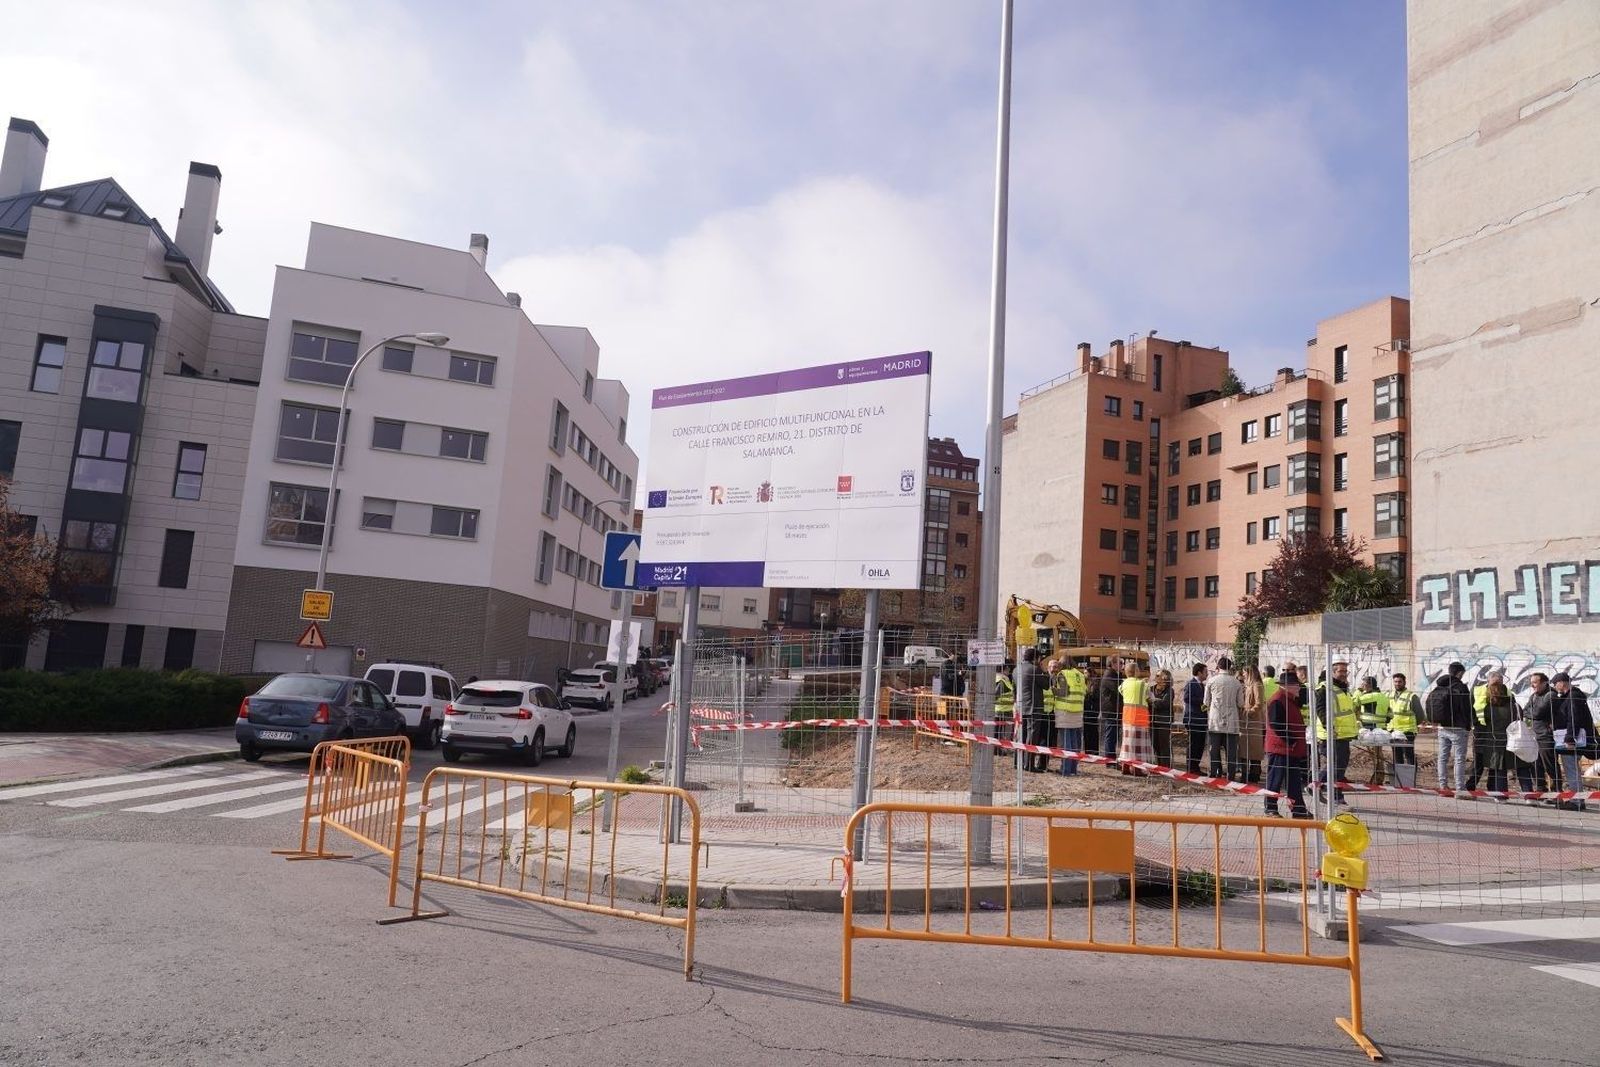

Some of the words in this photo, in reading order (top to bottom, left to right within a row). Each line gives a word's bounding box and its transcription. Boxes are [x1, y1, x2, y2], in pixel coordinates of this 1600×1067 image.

[883, 358, 921, 371] MADRID
[672, 418, 729, 437] CONSTRUCCIÓN
[731, 420, 742, 431] DE
[744, 417, 777, 430] EDIFICIO
[779, 409, 856, 426] MULTIFUNCIONAL
[858, 407, 871, 418] EN
[873, 405, 885, 416] LA
[688, 438, 711, 449] CALLE
[712, 434, 755, 447] FRANCISCO
[757, 430, 791, 443] REMIRO,
[809, 425, 848, 438] DISTRITO
[850, 423, 862, 434] DE
[654, 573, 673, 582] Capital
[868, 569, 890, 577] OHLA
